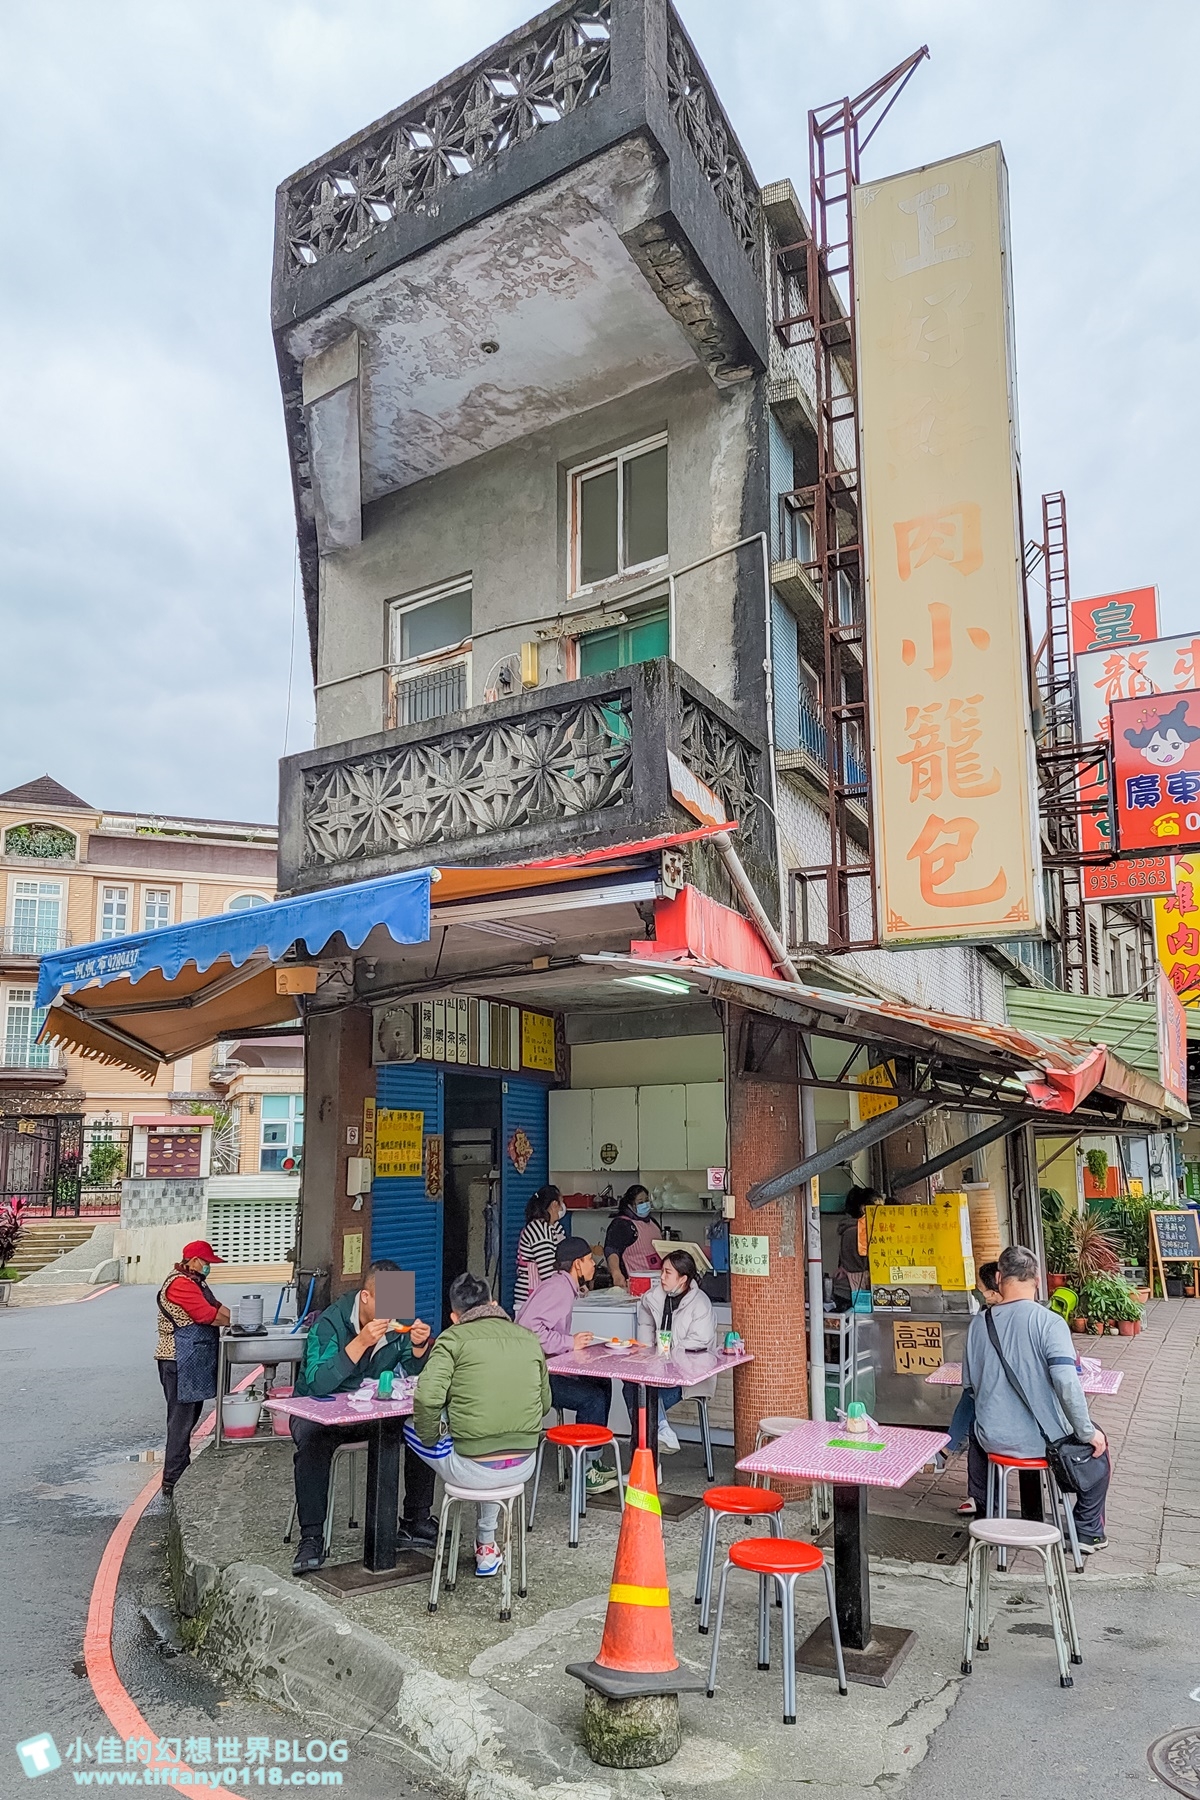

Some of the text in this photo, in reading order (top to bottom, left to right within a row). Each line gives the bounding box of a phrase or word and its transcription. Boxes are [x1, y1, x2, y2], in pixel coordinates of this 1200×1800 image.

[1090, 871, 1167, 890] 935-6363
[364, 1107, 374, 1160] 每週一公
[896, 1325, 942, 1349] 高溫
[899, 1351, 942, 1369] 小心
